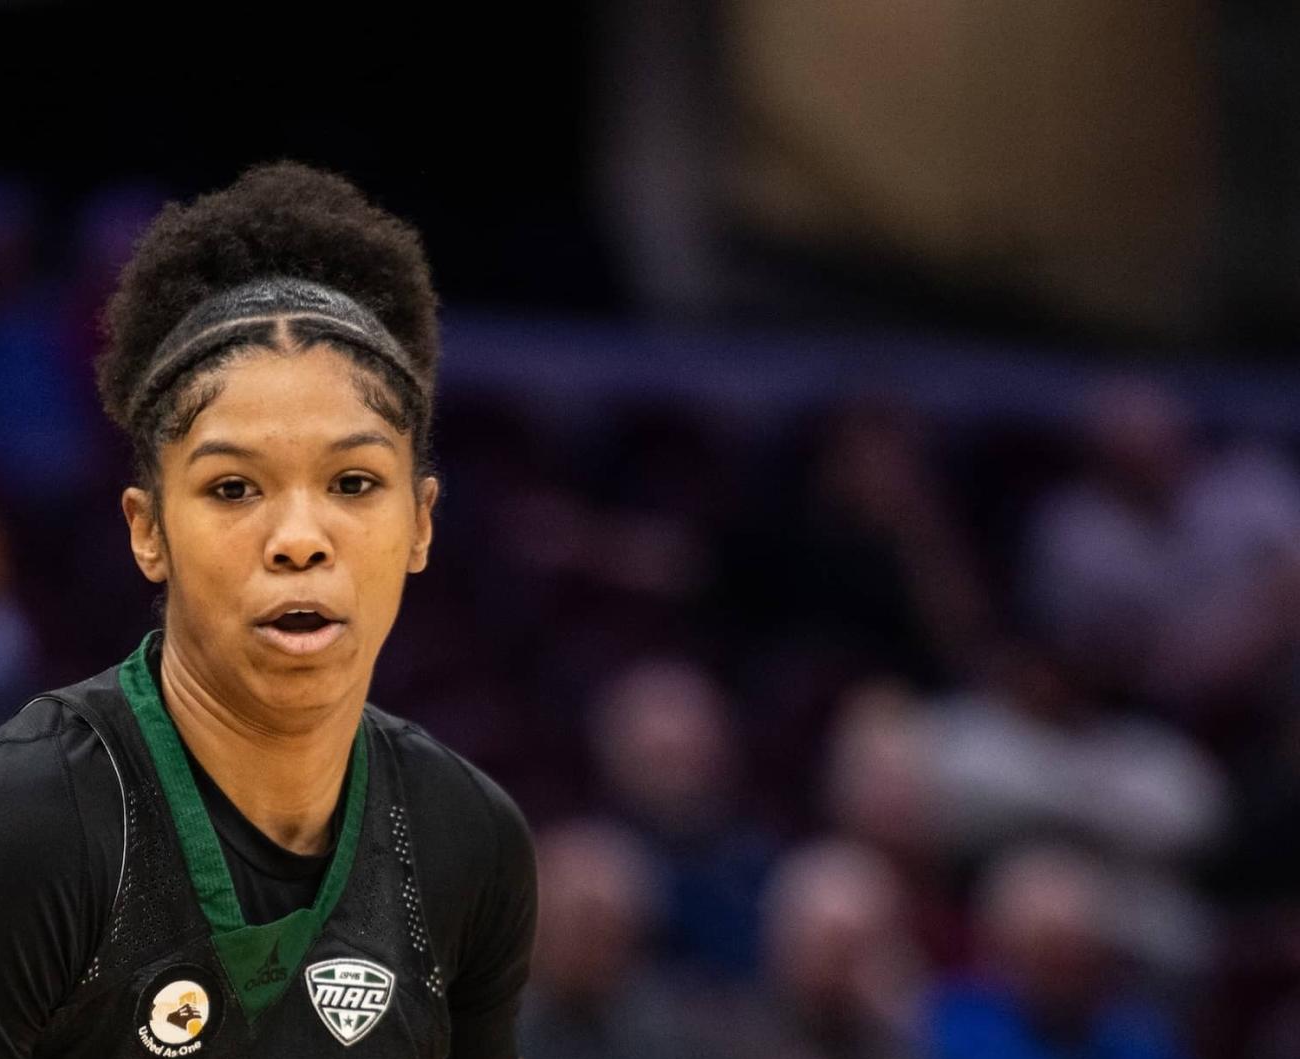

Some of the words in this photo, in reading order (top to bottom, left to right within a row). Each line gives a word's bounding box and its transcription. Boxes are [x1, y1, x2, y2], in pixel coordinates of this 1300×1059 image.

[313, 985, 387, 1011] MAC
[138, 1025, 165, 1056] United
[162, 1047, 178, 1058] As
[178, 1040, 202, 1056] One
